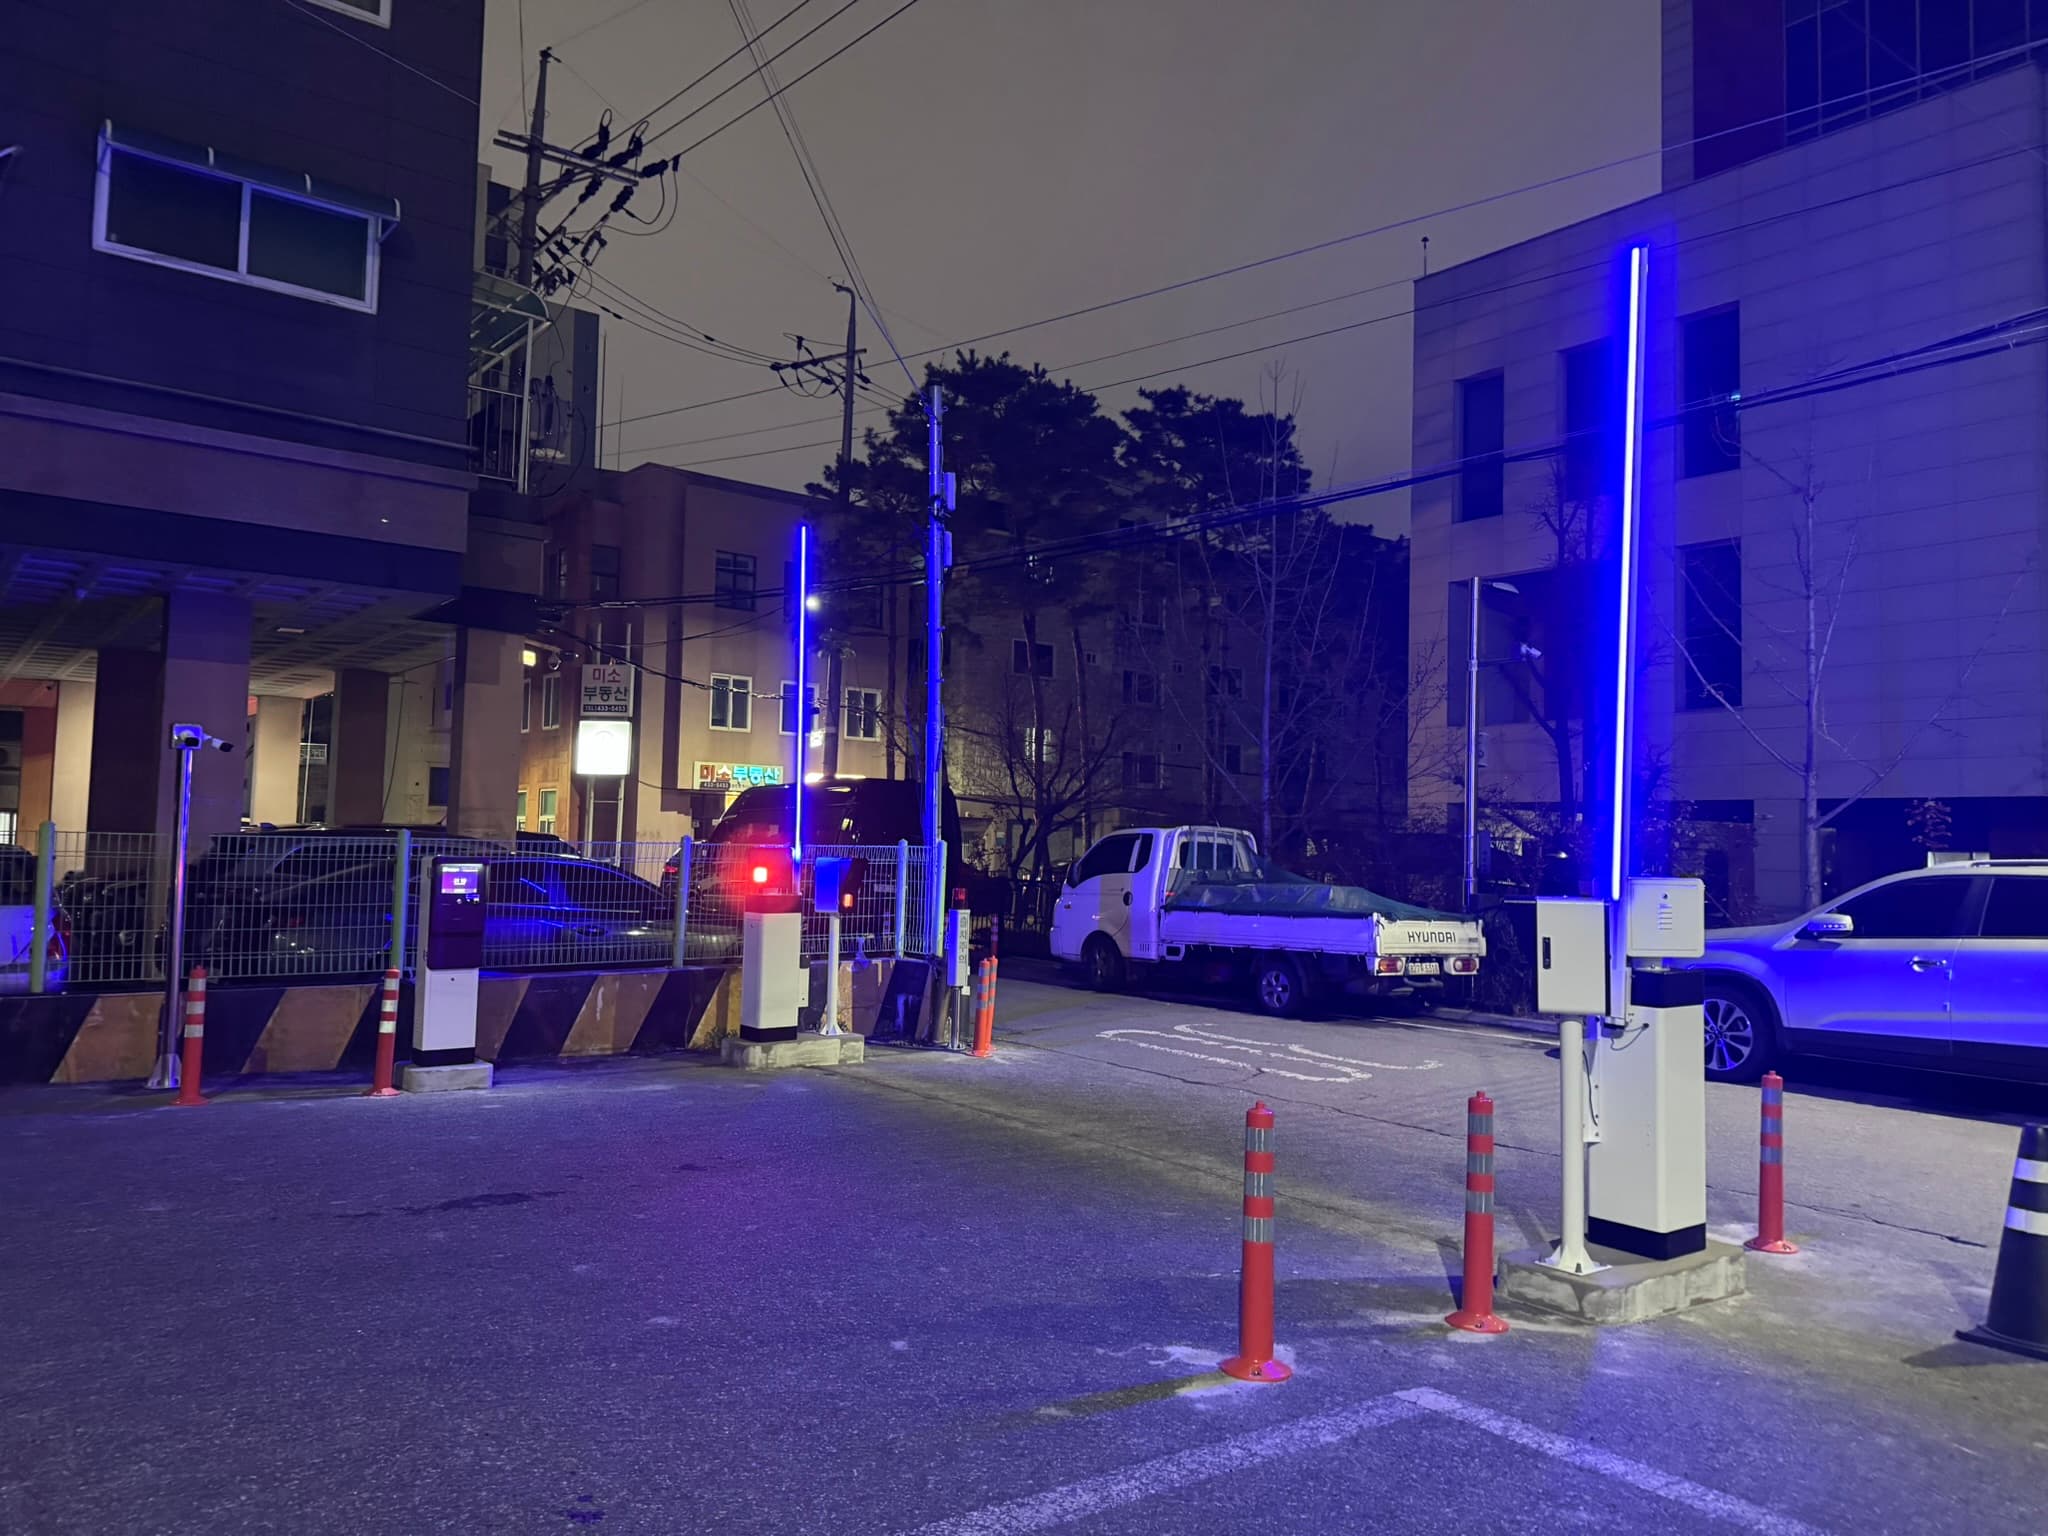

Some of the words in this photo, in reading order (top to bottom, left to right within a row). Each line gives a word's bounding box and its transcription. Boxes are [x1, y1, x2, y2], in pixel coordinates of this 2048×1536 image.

[593, 668, 621, 683] 미소
[583, 686, 628, 702] 부동산
[1407, 931, 1457, 943] HYUNDAI
